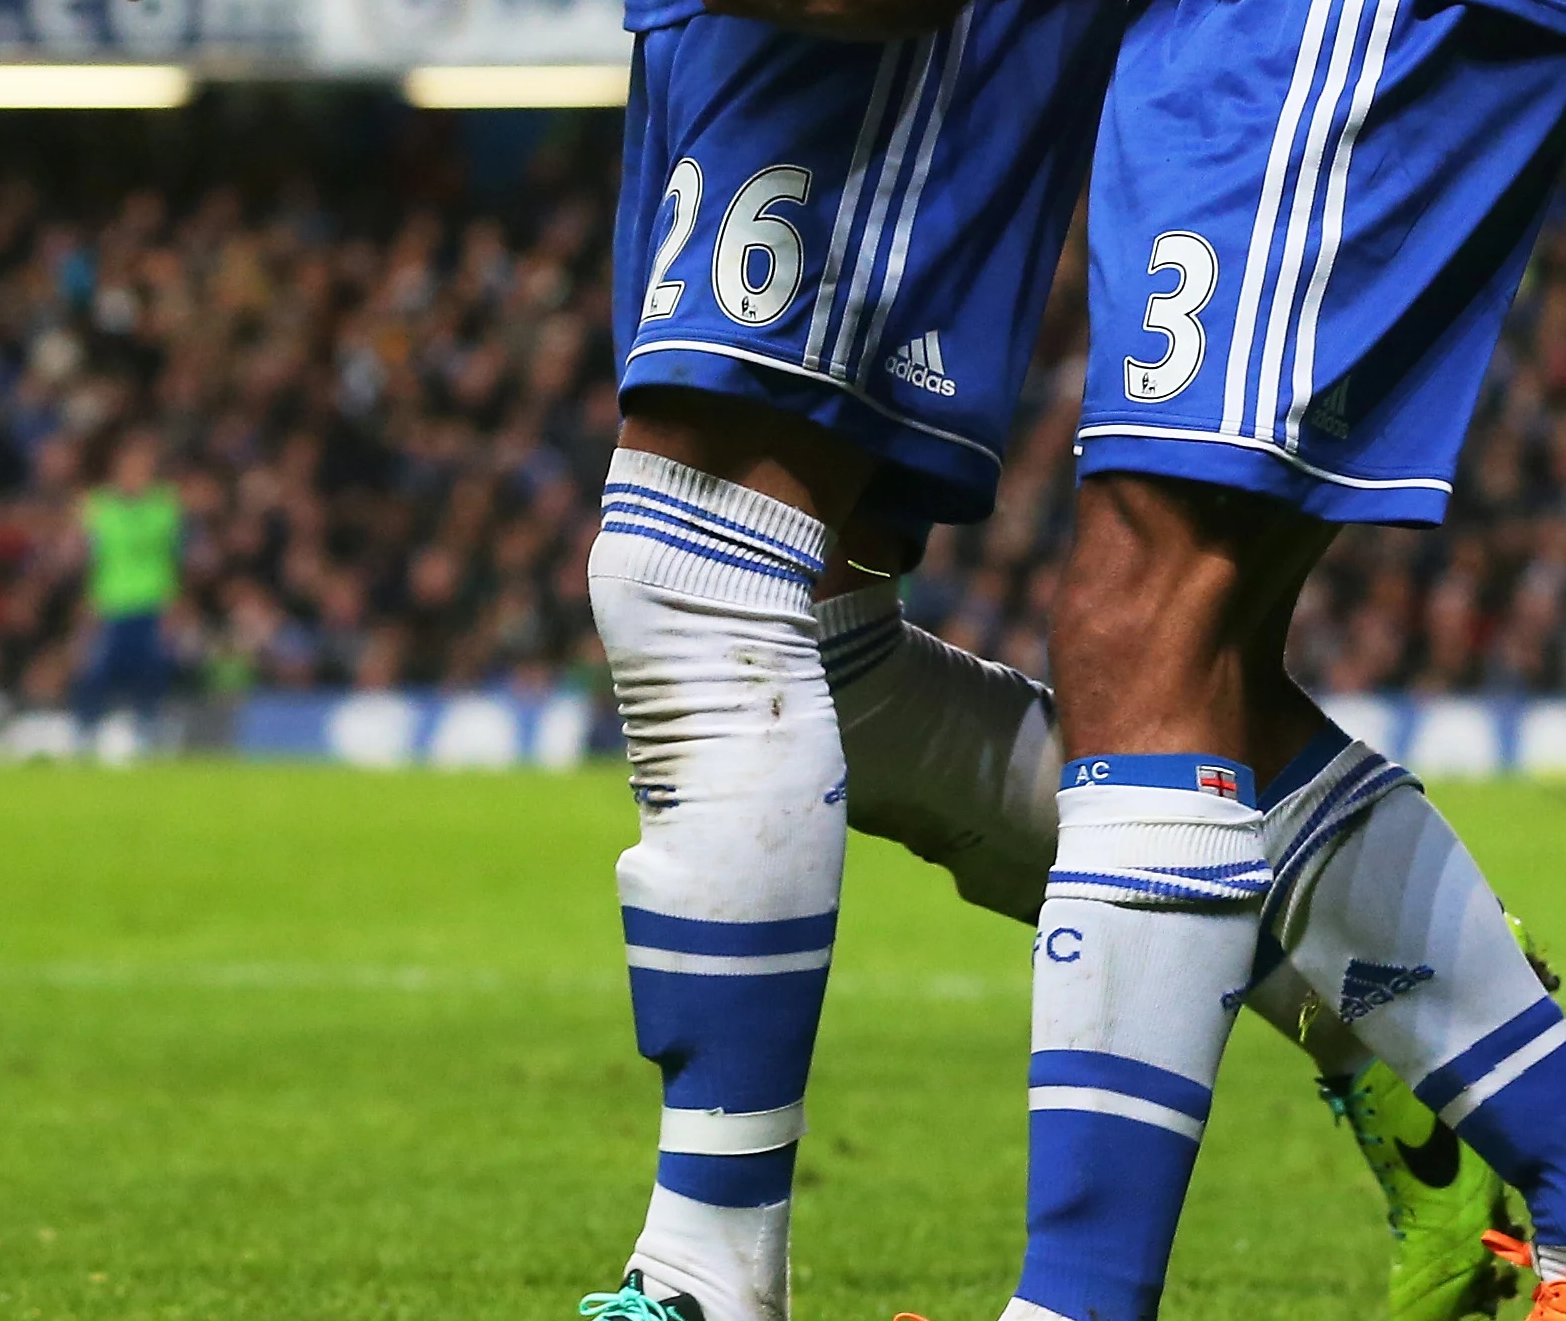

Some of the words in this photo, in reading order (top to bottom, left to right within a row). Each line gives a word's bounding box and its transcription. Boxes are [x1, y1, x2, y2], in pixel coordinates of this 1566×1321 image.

[640, 156, 813, 328] 26
[1124, 230, 1219, 404] 3
[885, 354, 958, 397] adidas
[1074, 761, 1111, 785] AC
